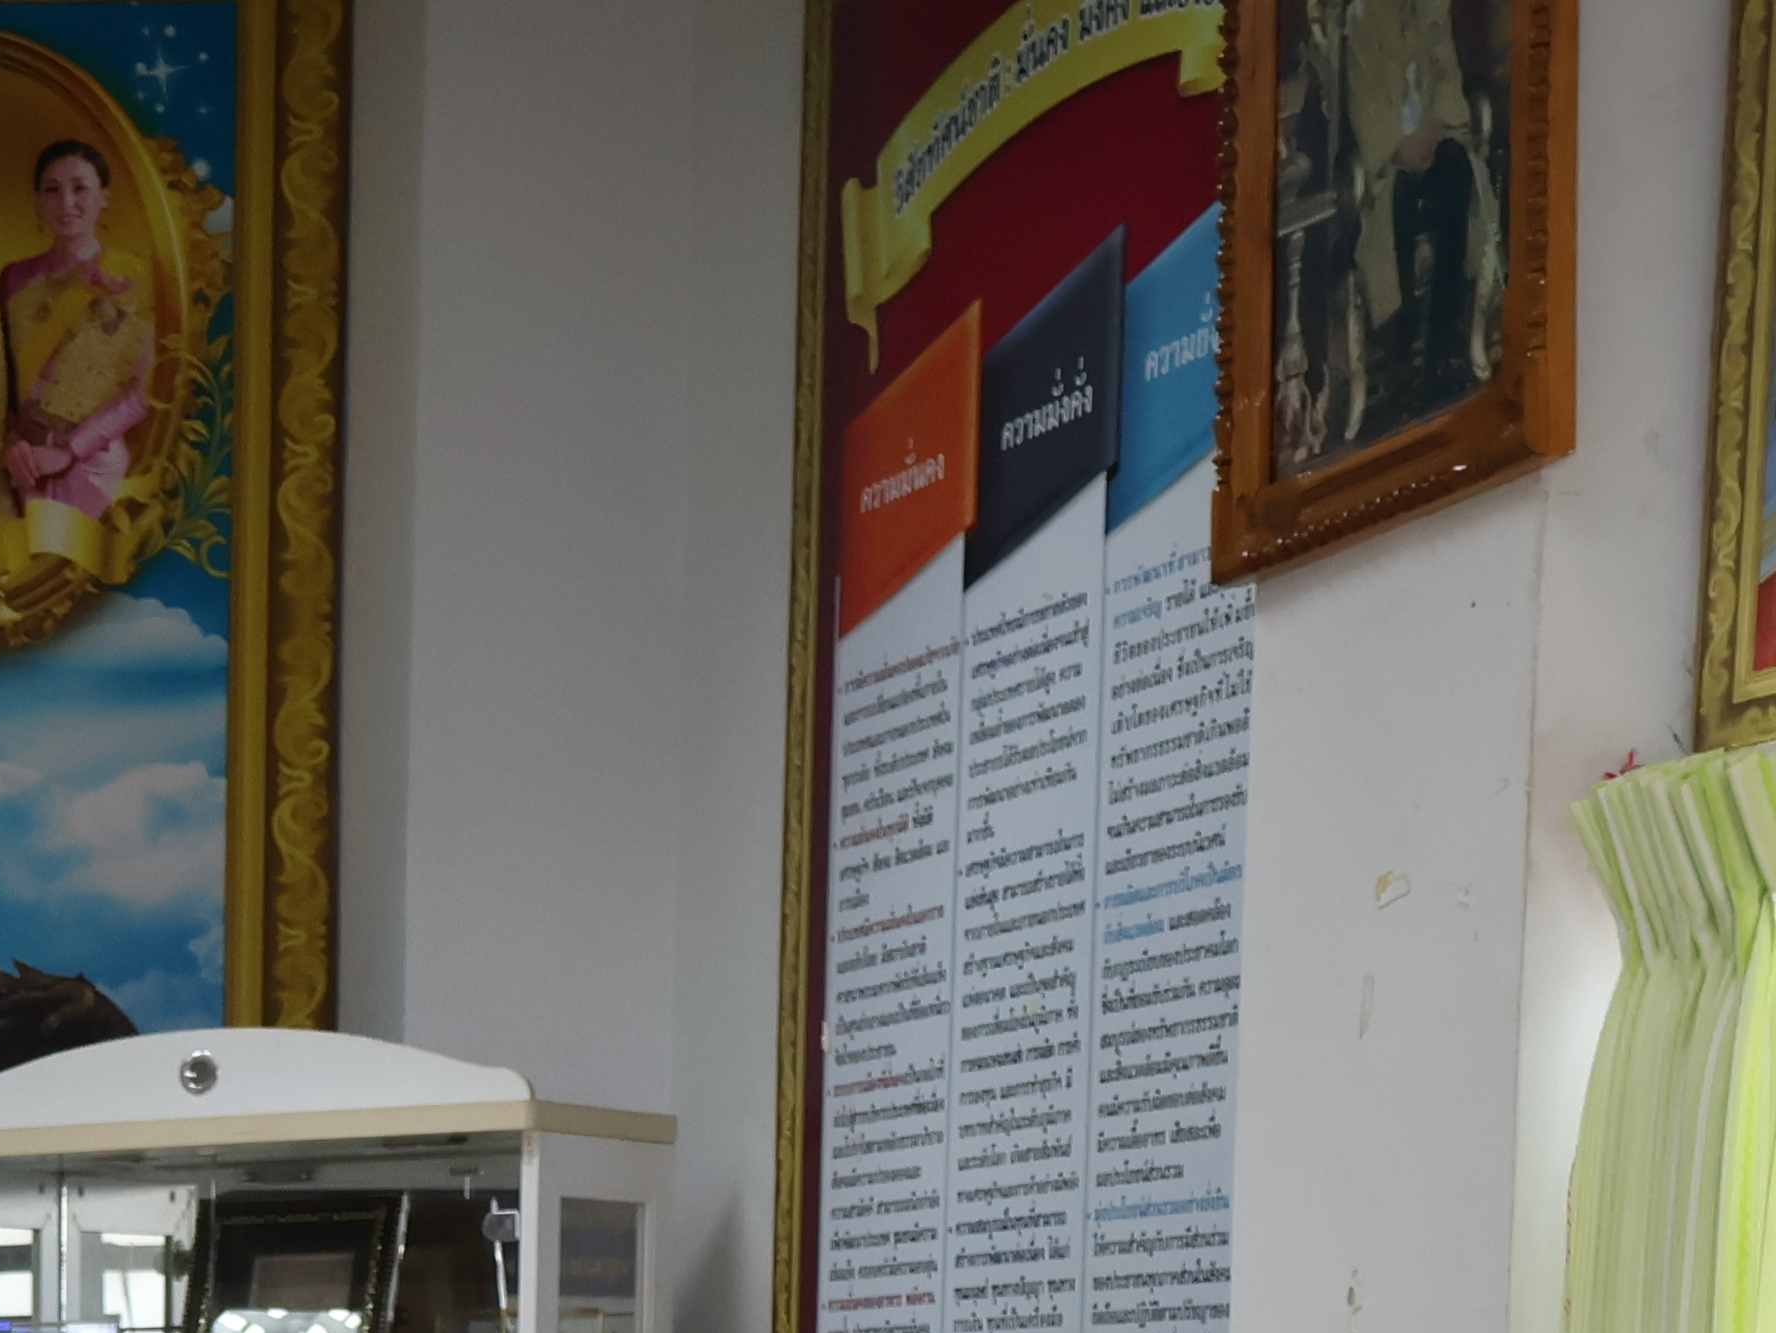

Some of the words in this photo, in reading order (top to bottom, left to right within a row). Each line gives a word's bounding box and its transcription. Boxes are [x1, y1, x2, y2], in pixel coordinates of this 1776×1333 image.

[1144, 292, 1219, 381] ความยั่
[1001, 358, 1094, 450] ความมั่งคั่ง
[860, 437, 945, 513] ความมั่นคง
